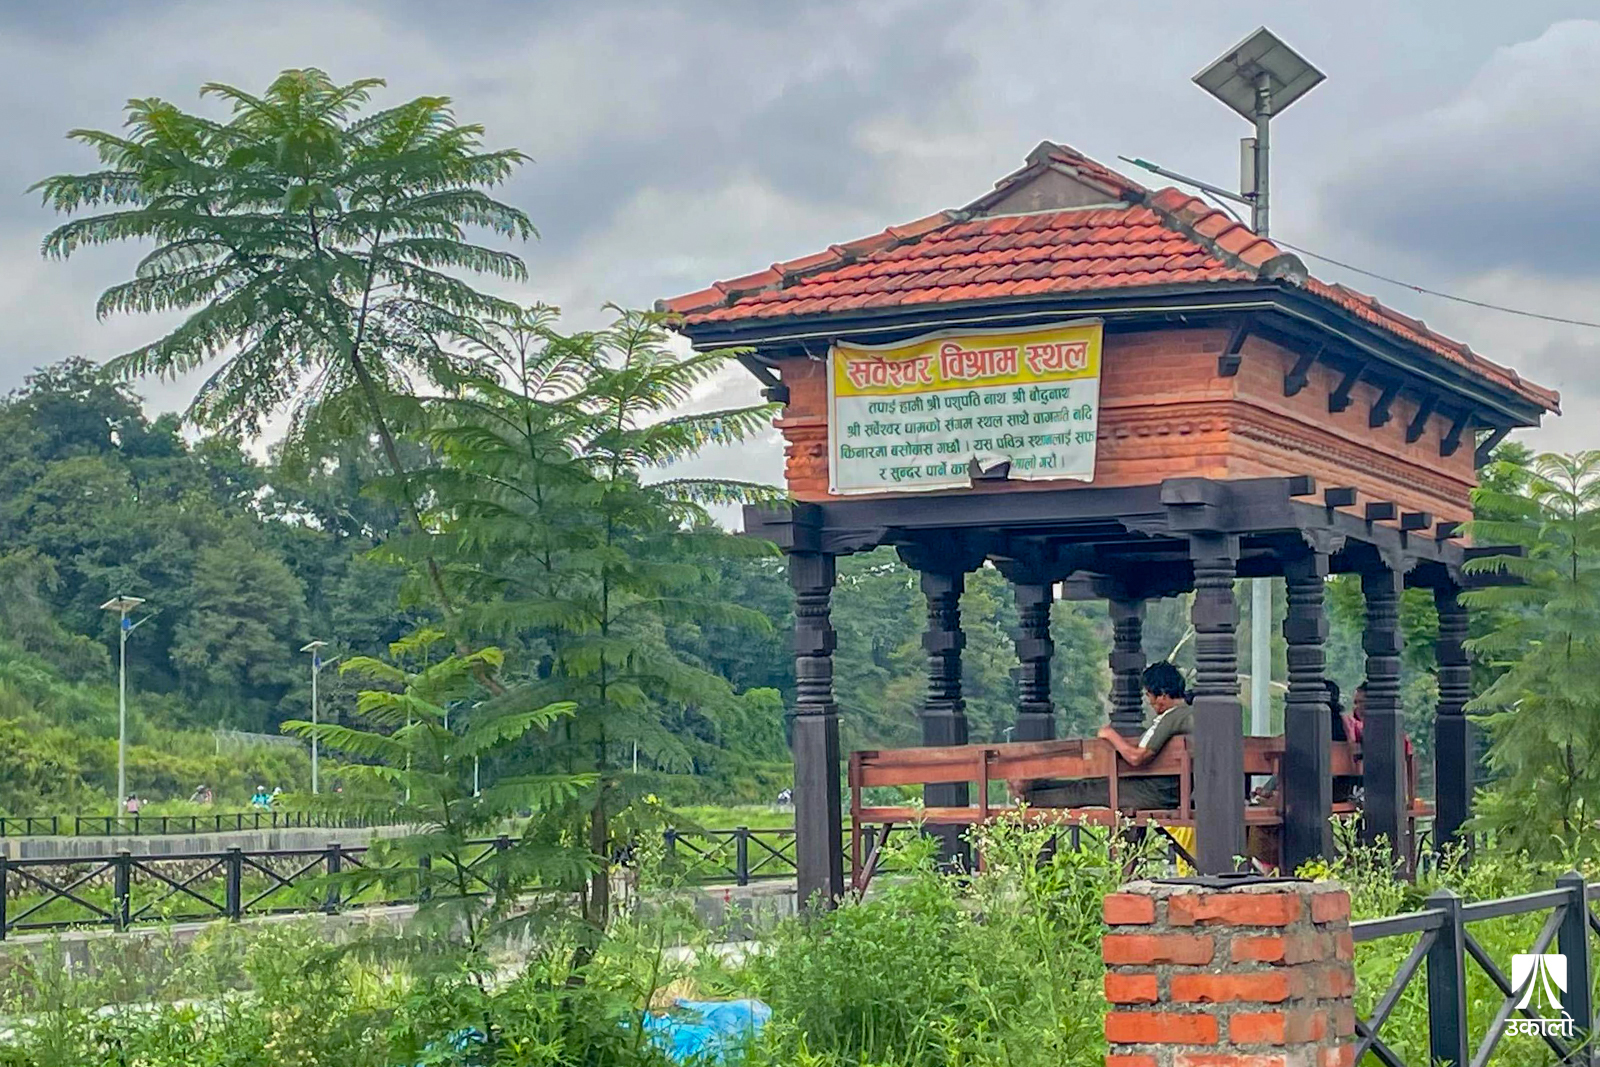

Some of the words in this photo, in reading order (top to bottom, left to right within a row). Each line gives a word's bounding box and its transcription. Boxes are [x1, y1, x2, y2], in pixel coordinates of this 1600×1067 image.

[849, 355, 933, 387] सर्वेश्वर
[940, 343, 1018, 379] विश्राम
[1026, 342, 1088, 374] स्थल
[899, 396, 924, 414] हामी
[927, 394, 941, 411] श्री
[943, 390, 981, 410] पशुपति
[1012, 387, 1026, 404] श्री
[847, 421, 861, 438] श्री
[864, 420, 902, 437] सर्वेश्वर
[944, 416, 973, 432] संगम
[977, 415, 1003, 429] स्थल
[840, 443, 888, 459] किनारमा
[973, 438, 993, 451] यस
[996, 433, 1025, 449] पवित्र
[879, 468, 888, 480] र
[890, 466, 922, 482] सुन्दर
